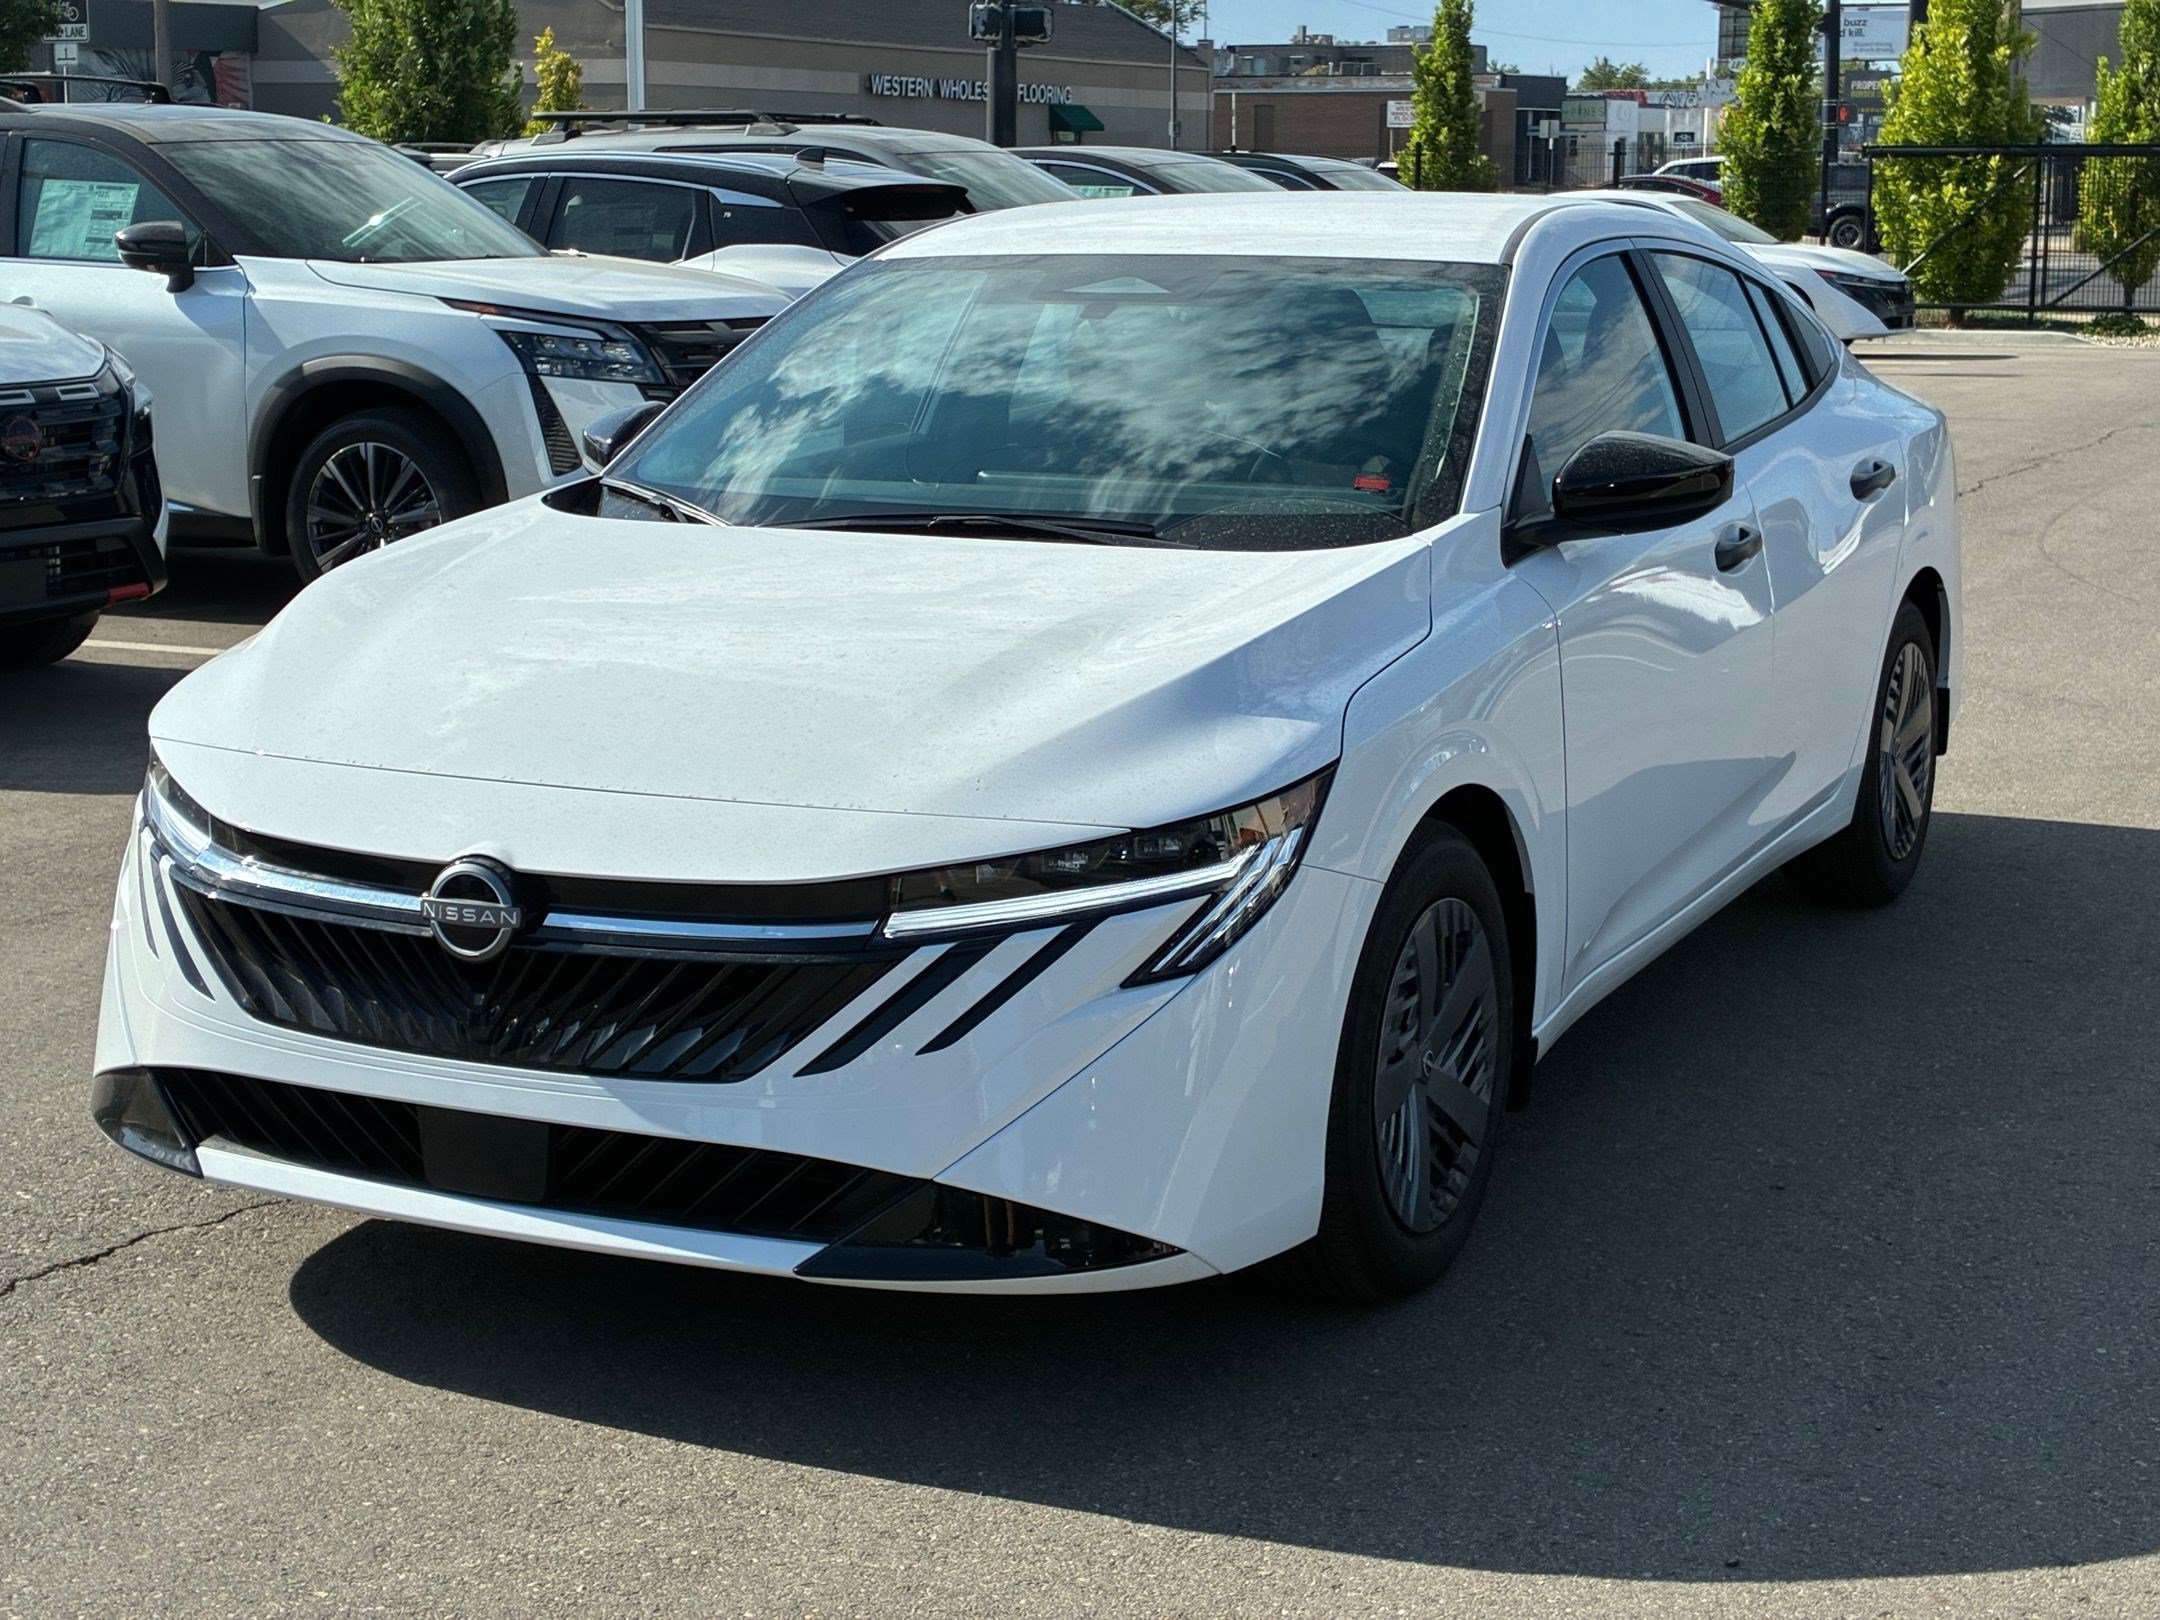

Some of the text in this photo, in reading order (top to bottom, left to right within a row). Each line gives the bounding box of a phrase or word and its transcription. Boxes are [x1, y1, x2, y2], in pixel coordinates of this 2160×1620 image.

[1844, 17, 1868, 26] buzz
[65, 26, 86, 38] LANE
[1849, 28, 1865, 37] kill.
[872, 74, 1072, 104] WESTERN WHOLES FLOORING
[423, 902, 517, 925] NISSAN
